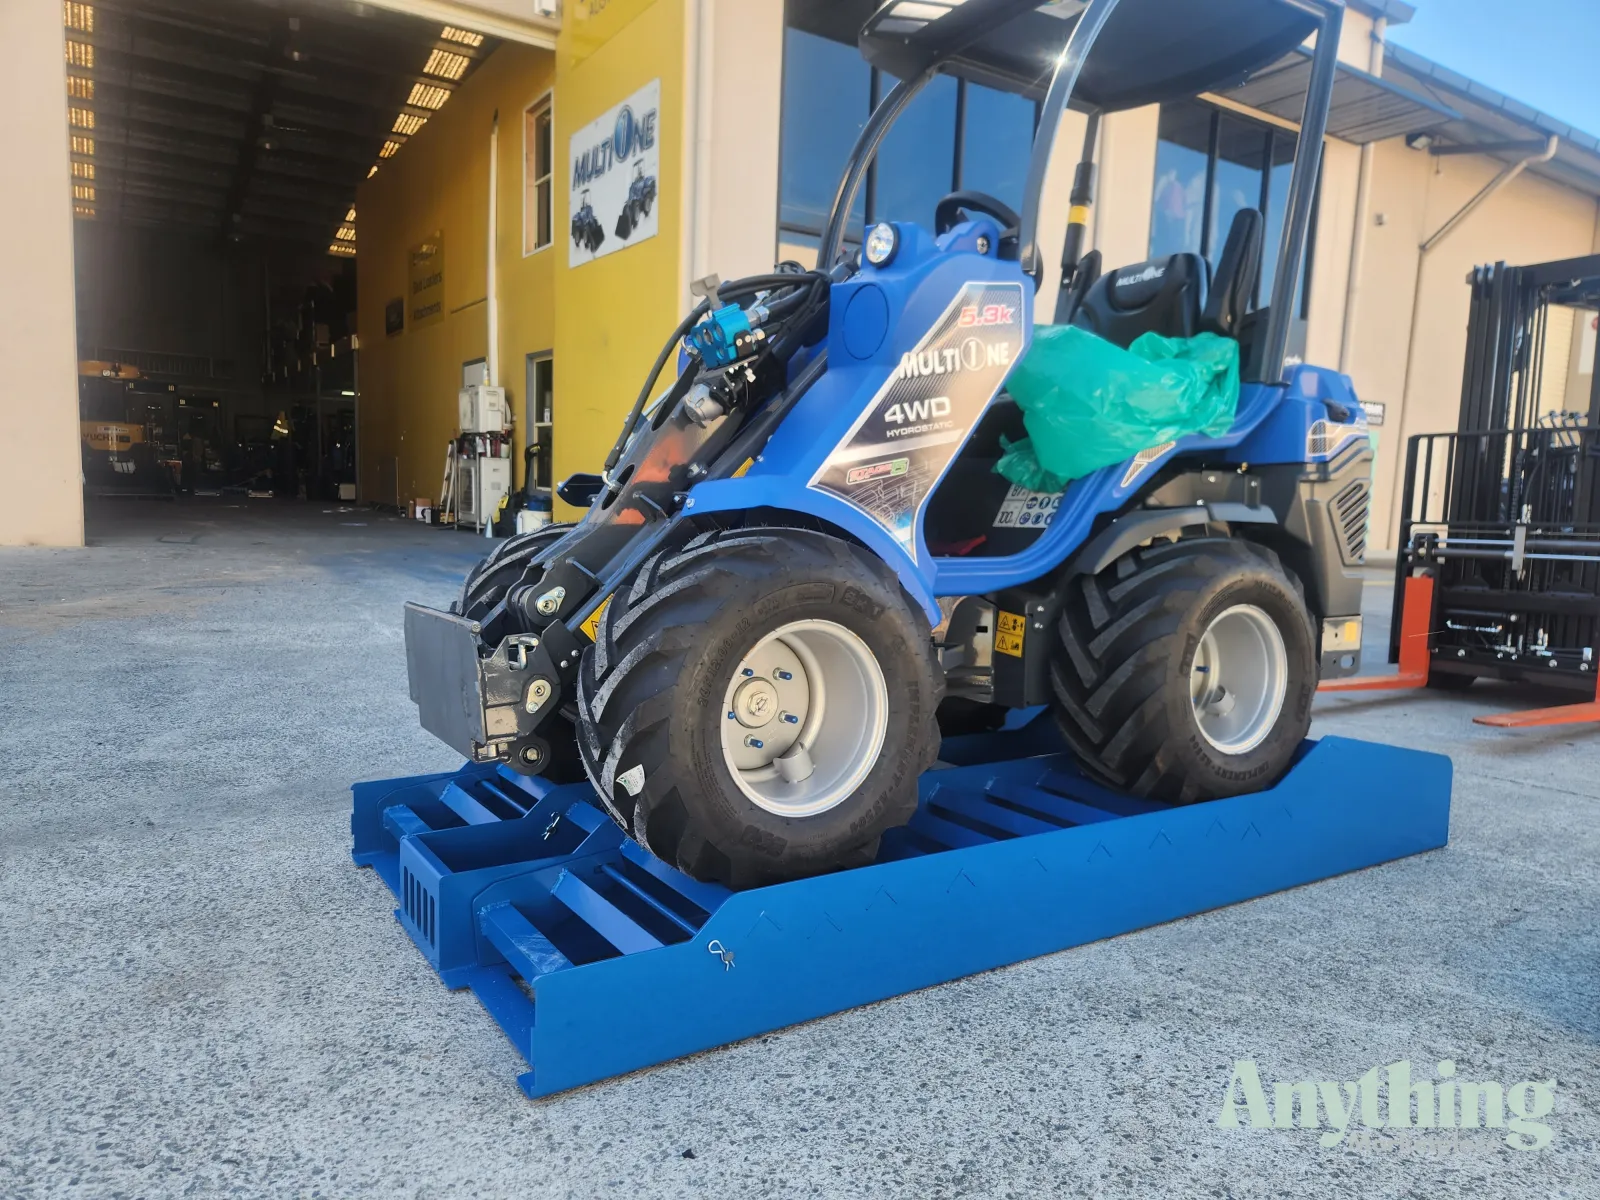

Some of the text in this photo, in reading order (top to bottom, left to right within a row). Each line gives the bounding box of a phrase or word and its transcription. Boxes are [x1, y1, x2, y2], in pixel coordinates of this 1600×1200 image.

[958, 305, 1013, 327] 5.3k
[884, 396, 951, 424] 4WD
[886, 421, 953, 438] HYDROSTATIC
